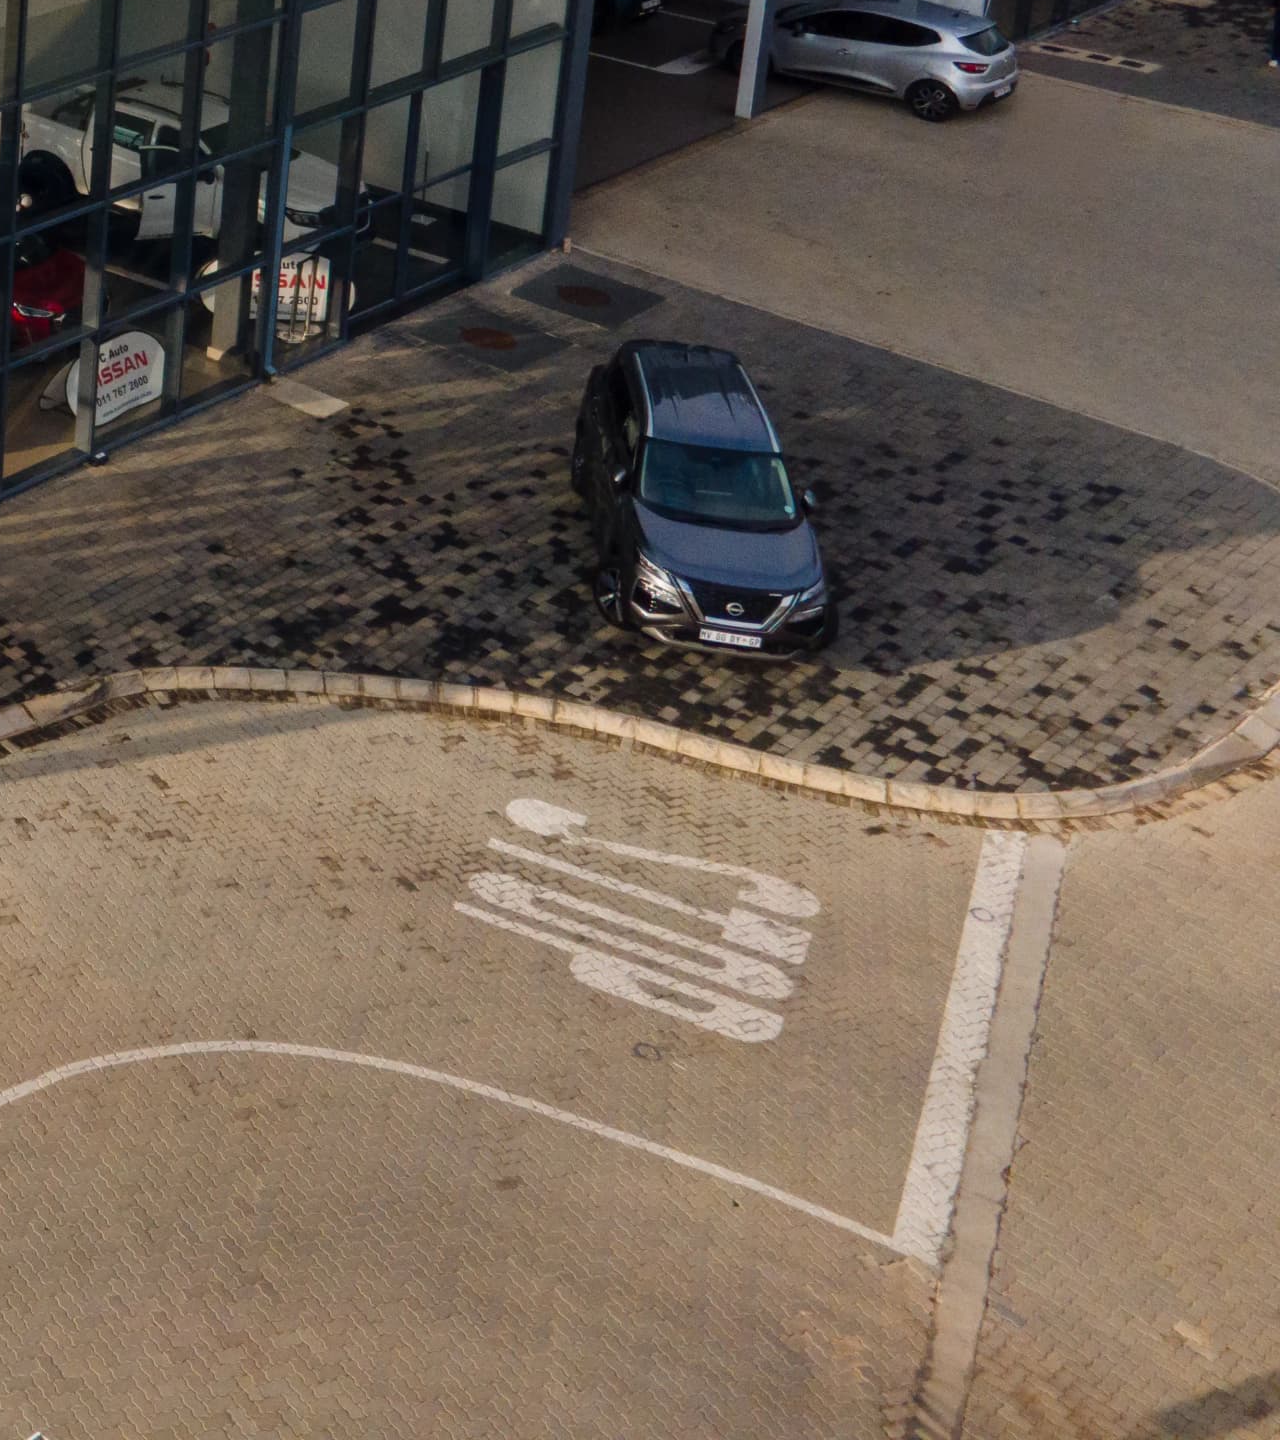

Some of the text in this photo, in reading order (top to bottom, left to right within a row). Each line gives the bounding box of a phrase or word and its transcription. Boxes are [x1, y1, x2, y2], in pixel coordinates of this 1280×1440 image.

[109, 344, 129, 359] Auto
[96, 350, 149, 387] ISSAN
[128, 375, 149, 391] 2600
